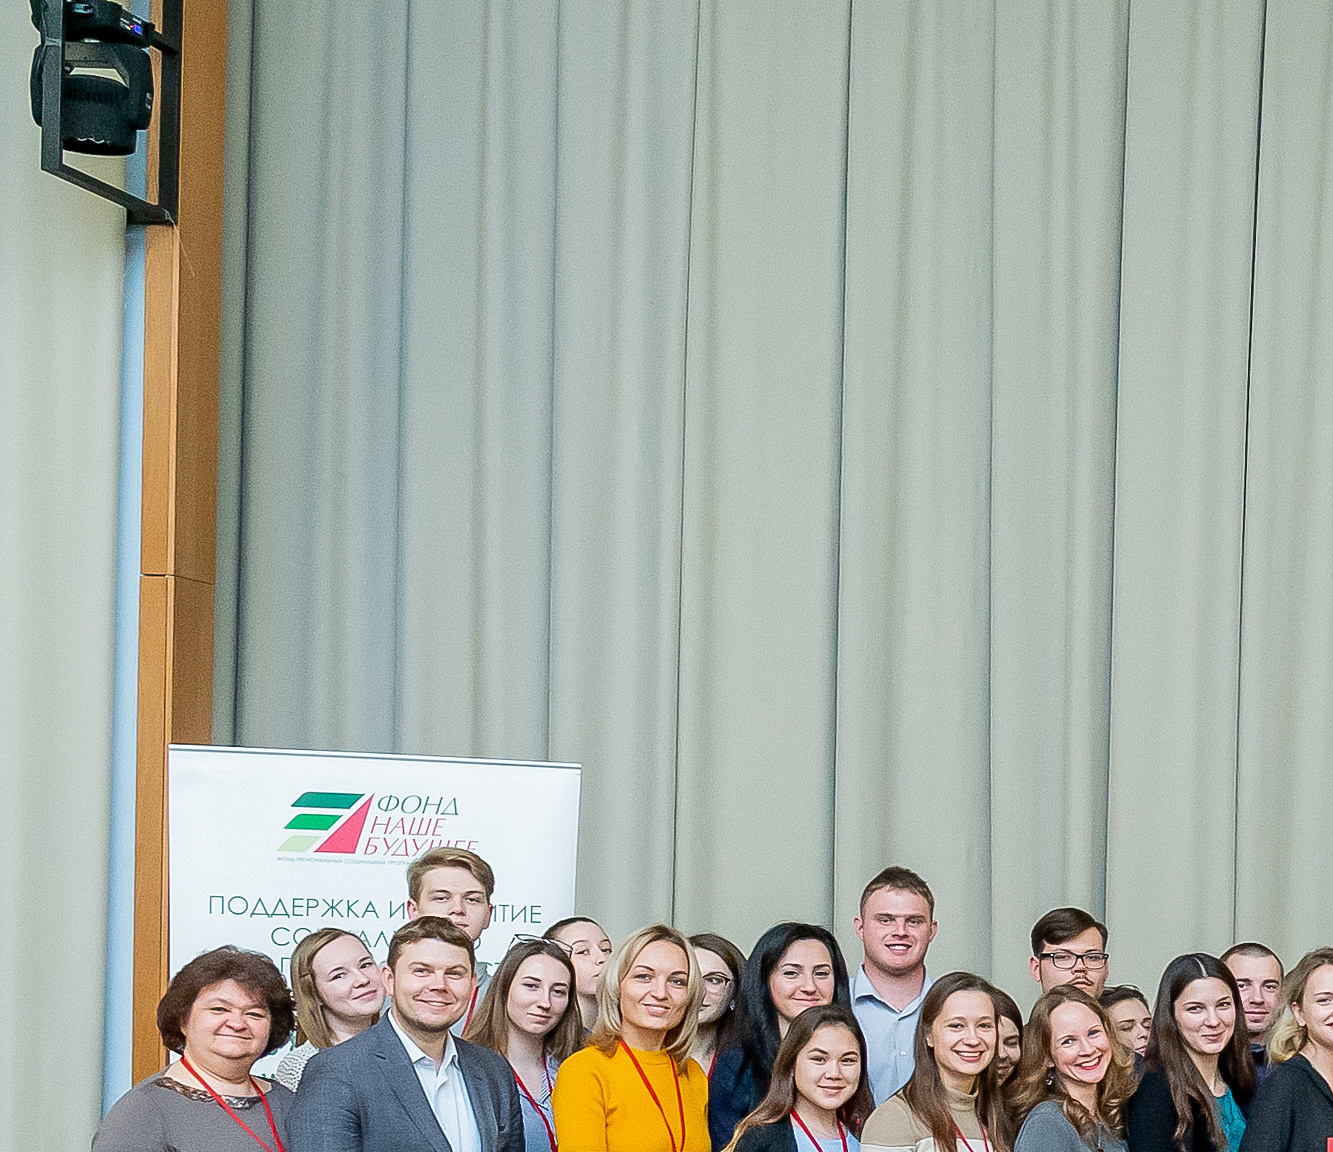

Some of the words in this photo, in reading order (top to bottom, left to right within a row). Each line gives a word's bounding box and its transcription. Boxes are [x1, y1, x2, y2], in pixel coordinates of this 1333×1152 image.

[377, 794, 459, 816] ФОНД
[370, 815, 447, 837] НАШЕ
[209, 895, 380, 919] ПОДДЕРЖКА
[389, 901, 405, 919] И
